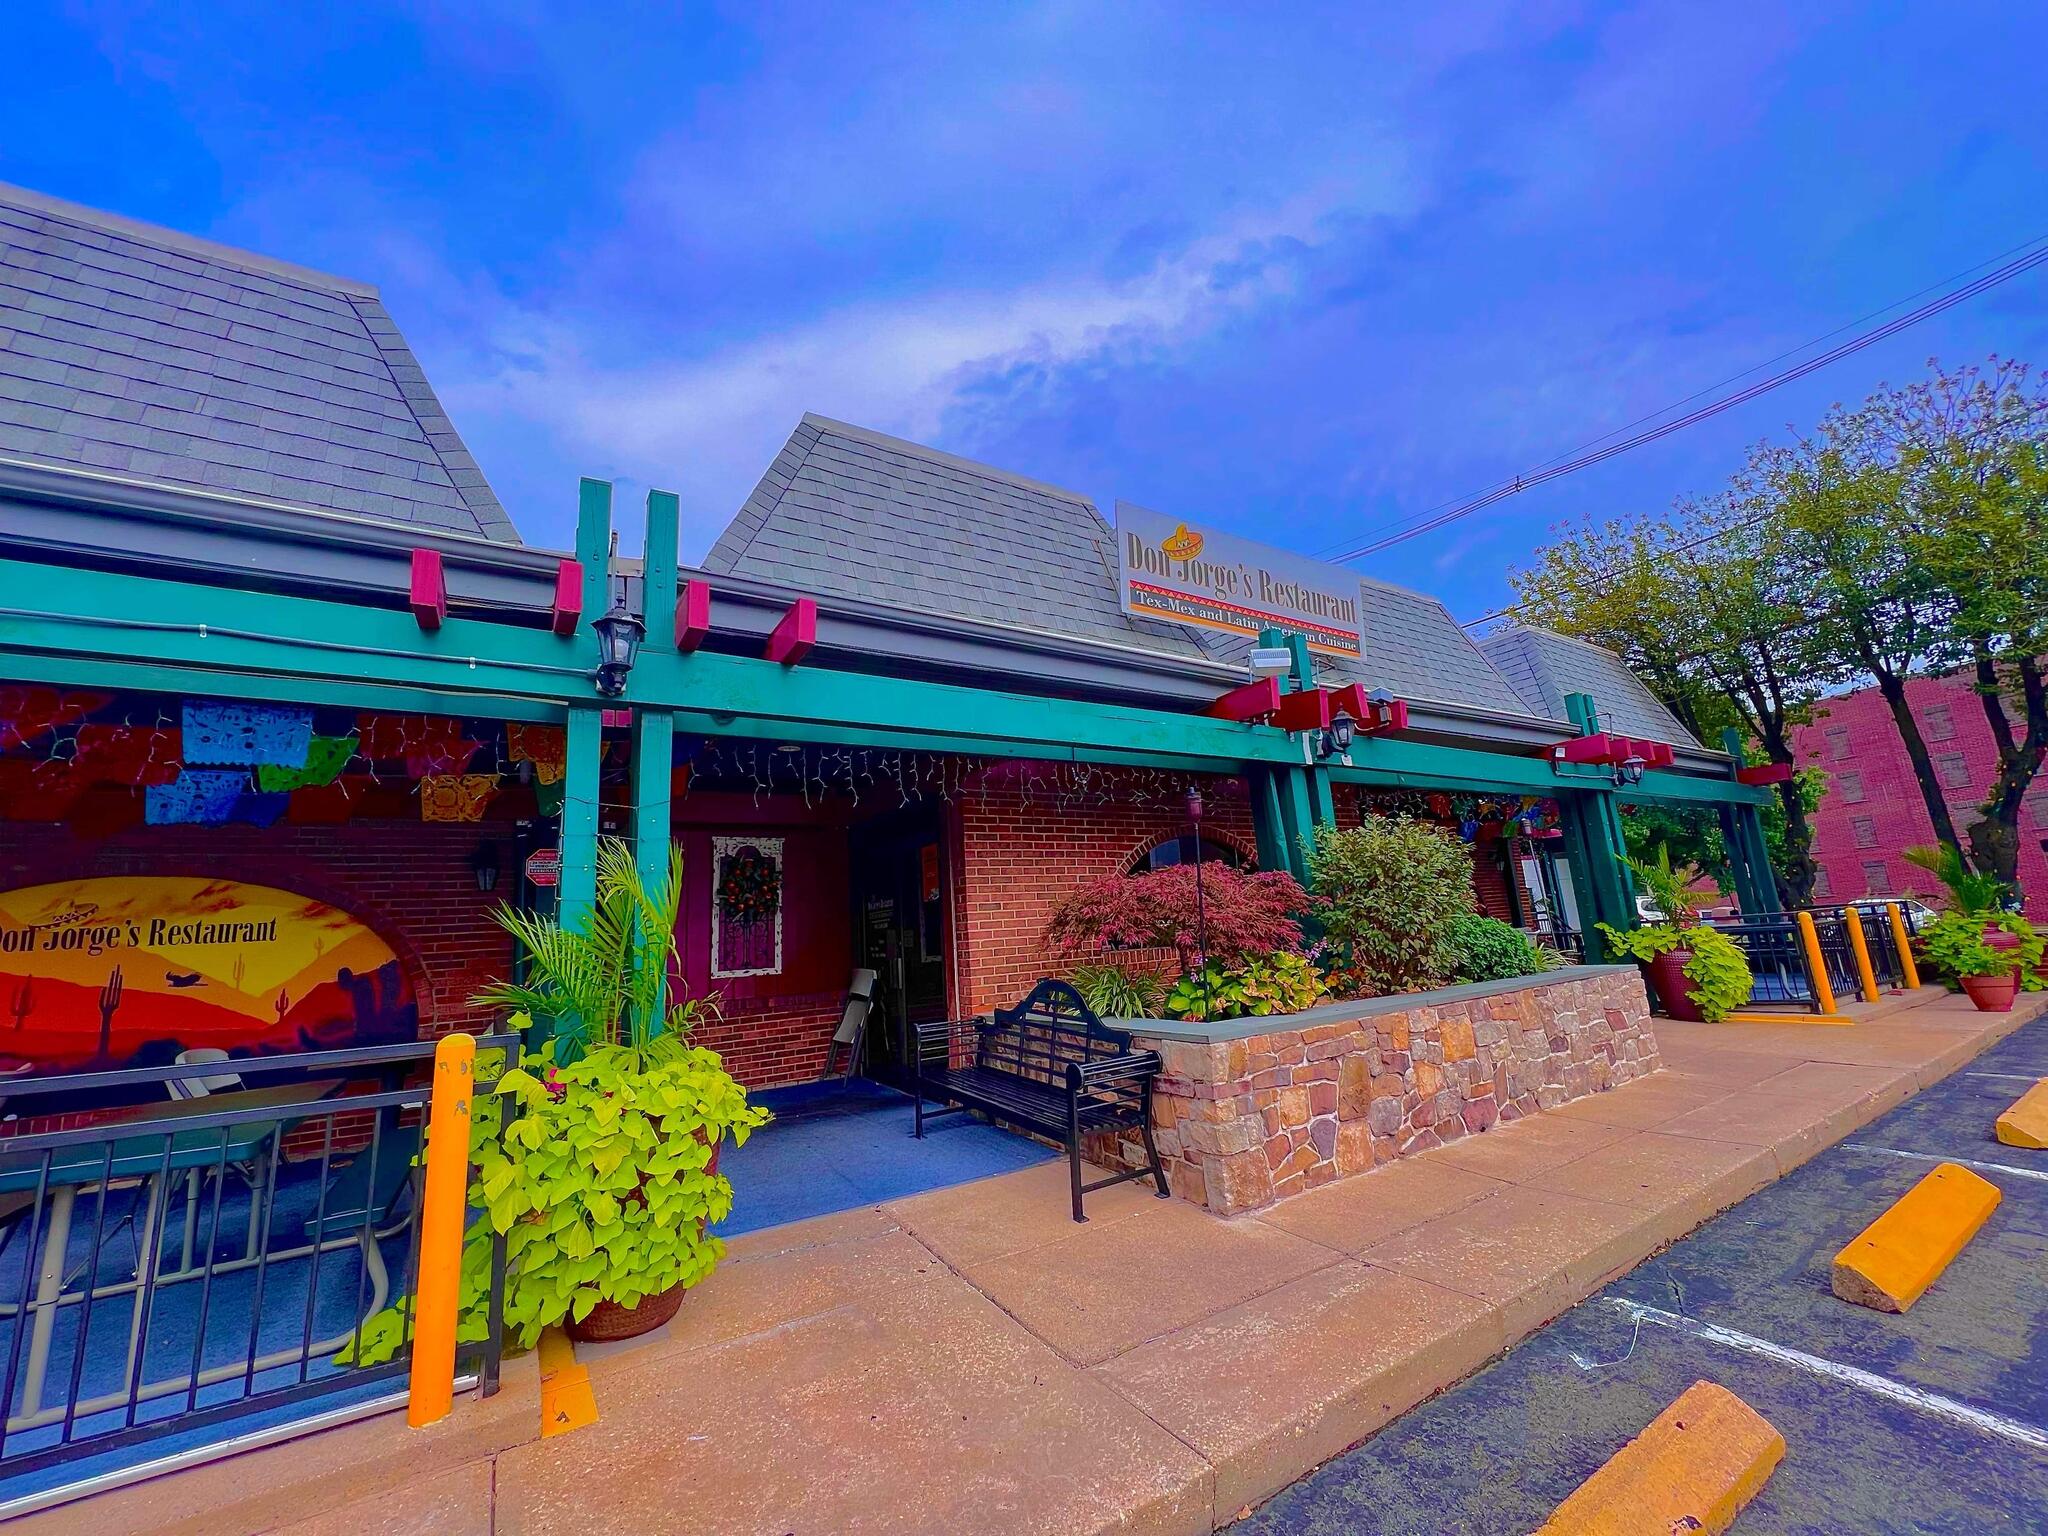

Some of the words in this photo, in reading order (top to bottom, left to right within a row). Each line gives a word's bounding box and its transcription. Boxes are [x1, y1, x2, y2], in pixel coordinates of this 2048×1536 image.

[1127, 532, 1171, 577] Don
[1177, 559, 1253, 600] Jorge's
[1258, 568, 1358, 624] Restaurant
[1136, 590, 1196, 616] Tex-Mex
[1199, 608, 1224, 622] and
[1227, 612, 1260, 630] Latin
[1318, 632, 1357, 651] Cuisine
[0, 925, 37, 952] on
[42, 919, 141, 957] Jorge's
[147, 917, 277, 947] Restaurant
